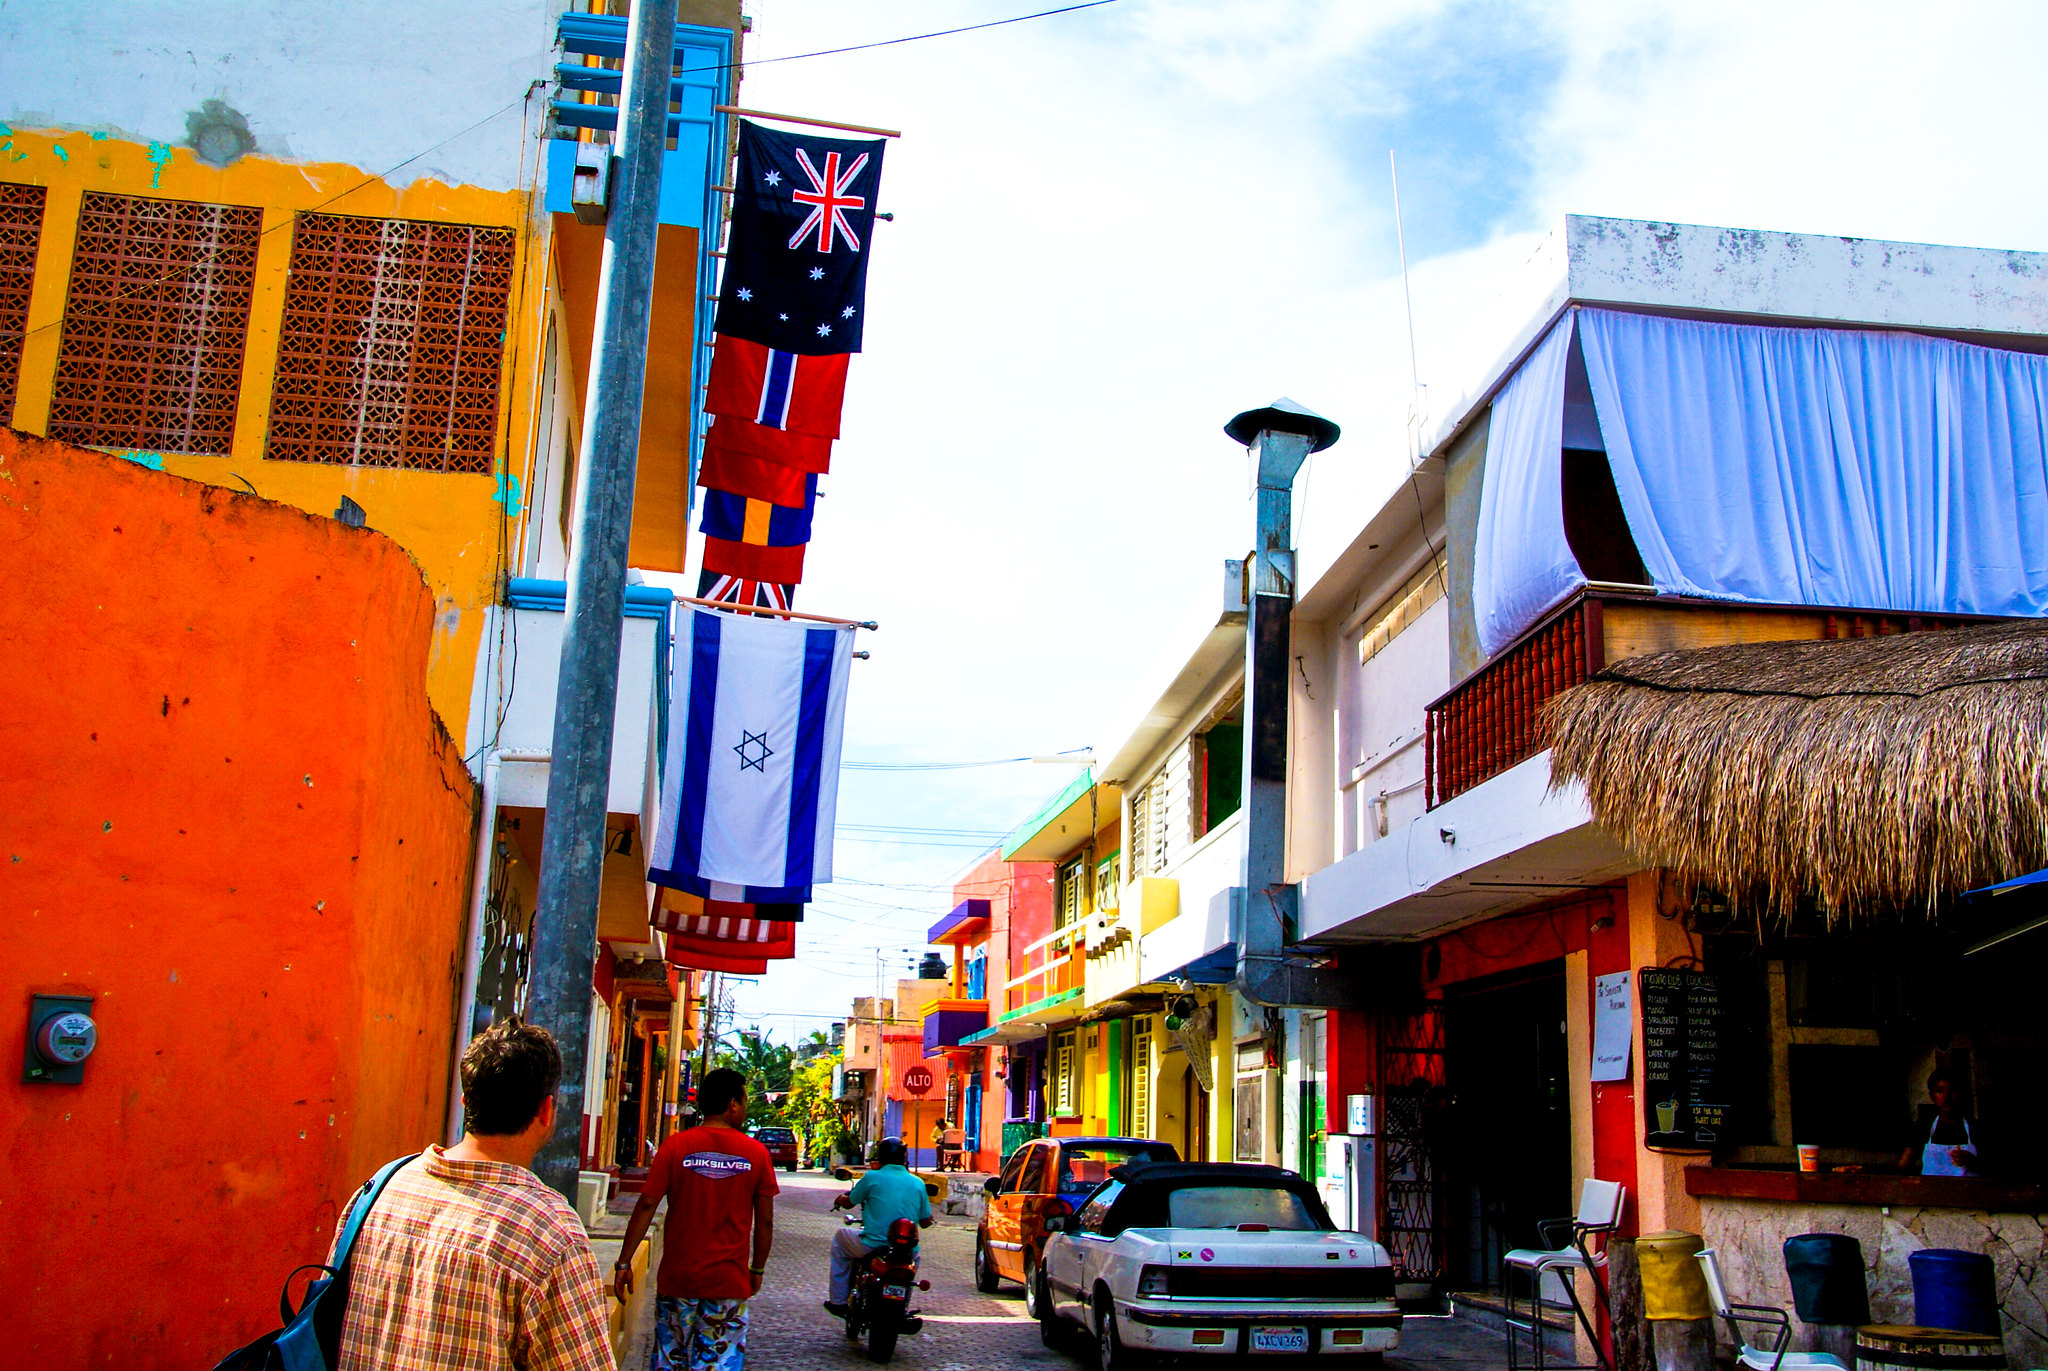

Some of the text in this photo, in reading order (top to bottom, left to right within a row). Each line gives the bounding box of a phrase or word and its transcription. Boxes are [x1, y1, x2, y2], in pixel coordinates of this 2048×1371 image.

[1644, 974, 1682, 986] MOJITO CLUB
[1647, 1027, 1676, 1036] CRANBERRY
[1648, 1038, 1664, 1047] PEACH
[906, 1074, 932, 1087] ALTO
[1352, 1106, 1367, 1126] ICE
[683, 1159, 752, 1171] QUIKSILVER
[1257, 1335, 1303, 1348] 4XCV369
